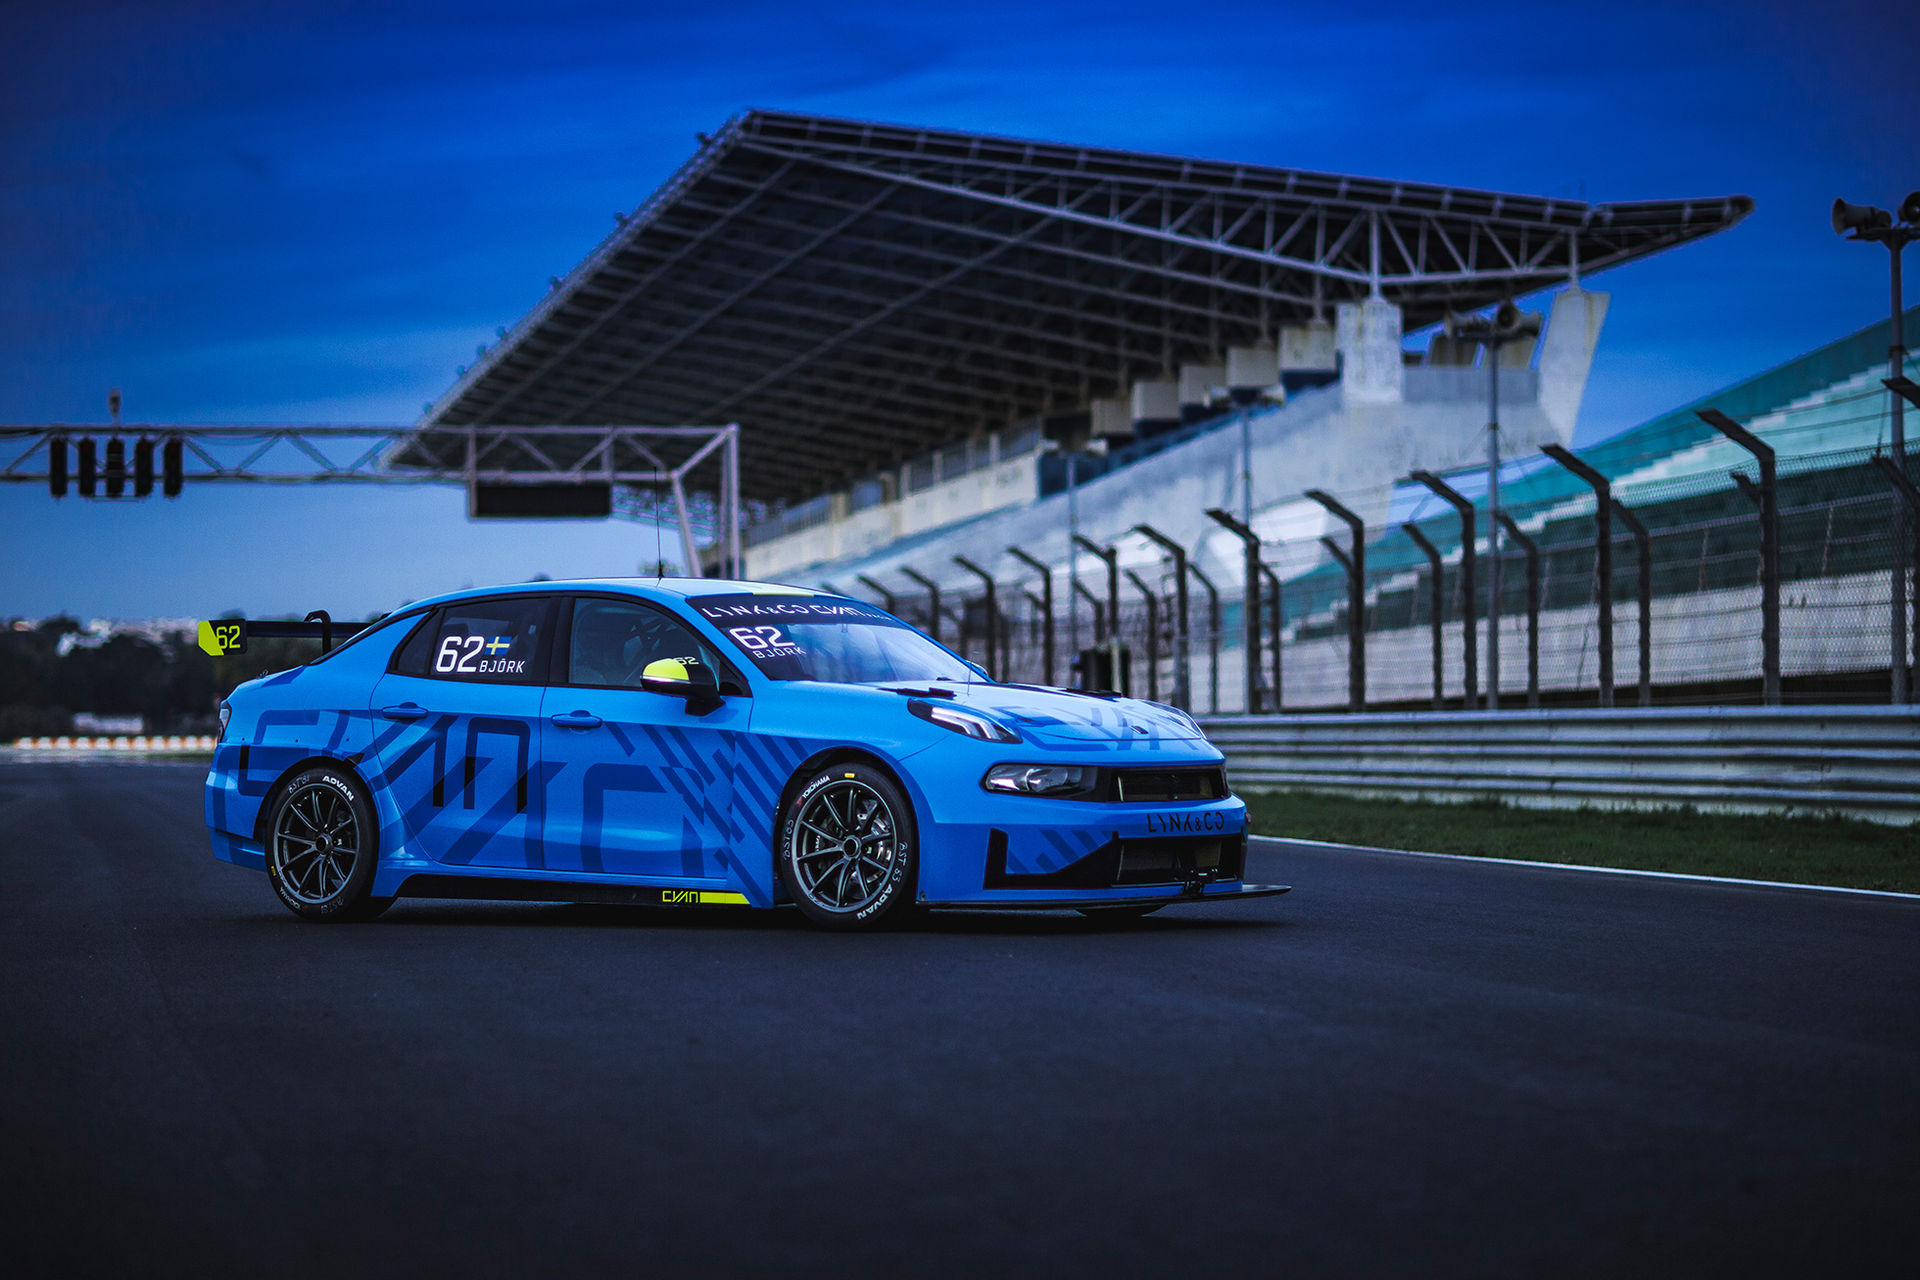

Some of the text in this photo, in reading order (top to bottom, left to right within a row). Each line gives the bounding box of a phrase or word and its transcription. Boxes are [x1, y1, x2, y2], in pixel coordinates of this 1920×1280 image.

[215, 625, 241, 649] 62
[728, 625, 796, 650] 62
[435, 635, 485, 673] 62
[322, 775, 355, 802] ADVAN
[801, 775, 831, 799] YOKOHAMA
[856, 883, 893, 920] ADVAN
